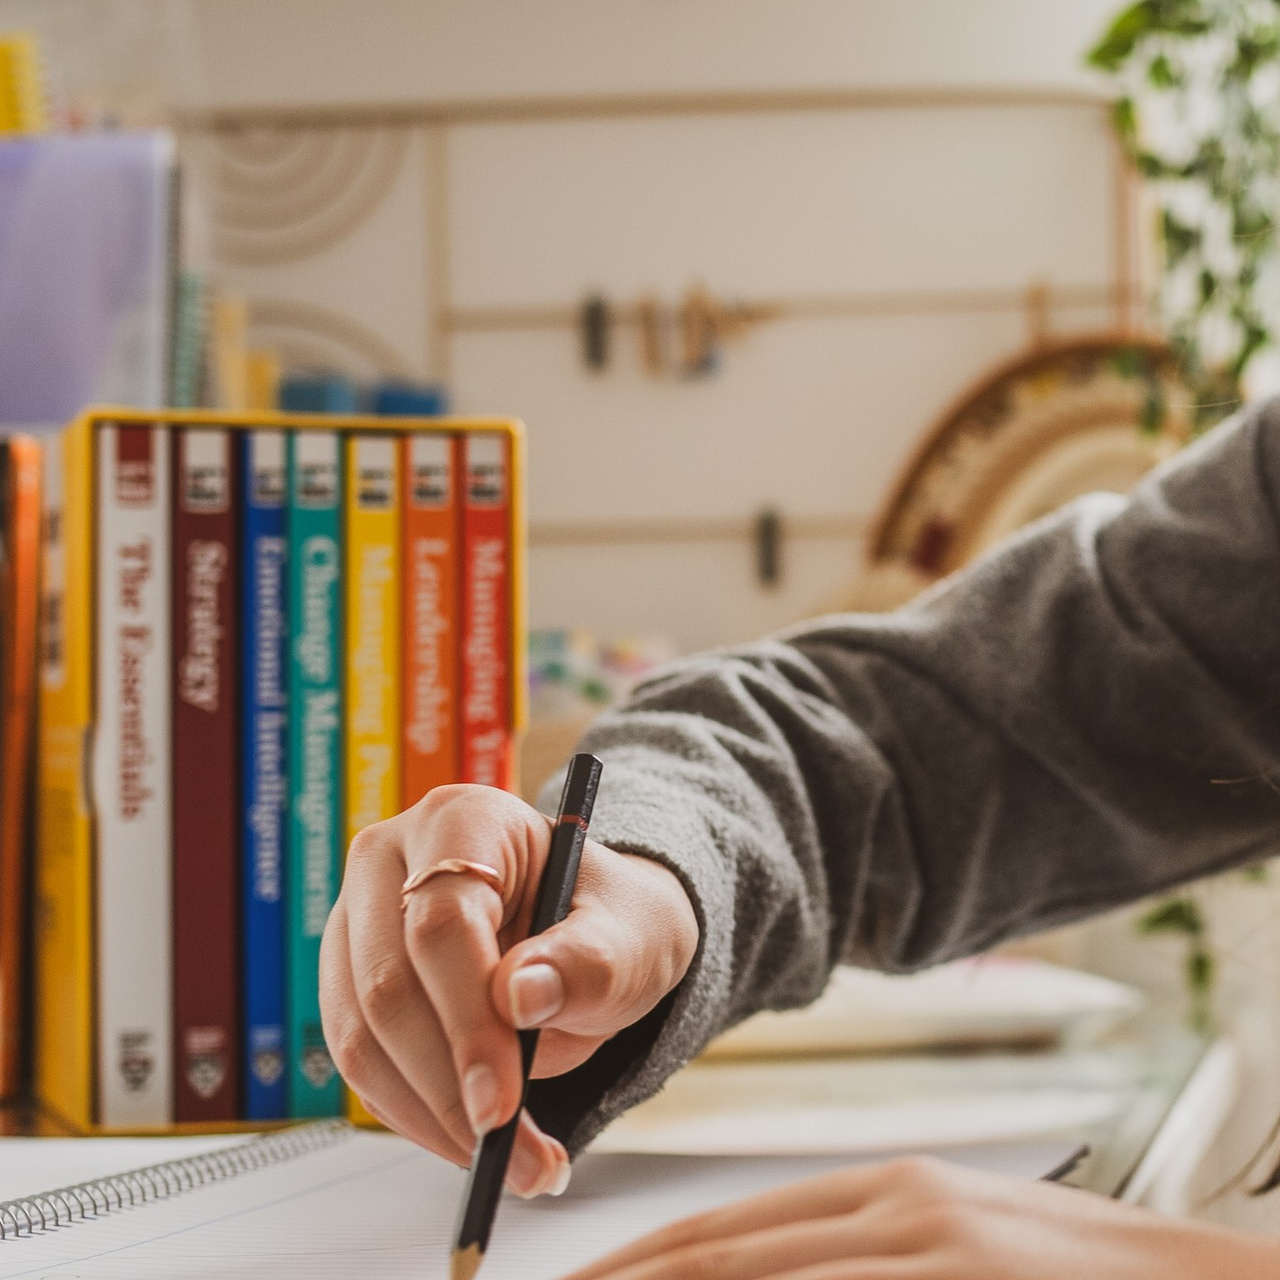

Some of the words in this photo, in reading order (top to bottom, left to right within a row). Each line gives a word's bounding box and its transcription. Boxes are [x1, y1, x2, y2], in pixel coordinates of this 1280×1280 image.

[119, 537, 153, 612] The
[179, 539, 228, 713] Strategy
[254, 537, 288, 705] Emotional
[294, 536, 338, 683] Change
[352, 543, 394, 736] Managing
[405, 539, 449, 755] Leadership
[463, 538, 505, 721] Managing
[119, 624, 153, 821] Essentials
[249, 712, 288, 903] Intelligence
[296, 687, 338, 937] Management
